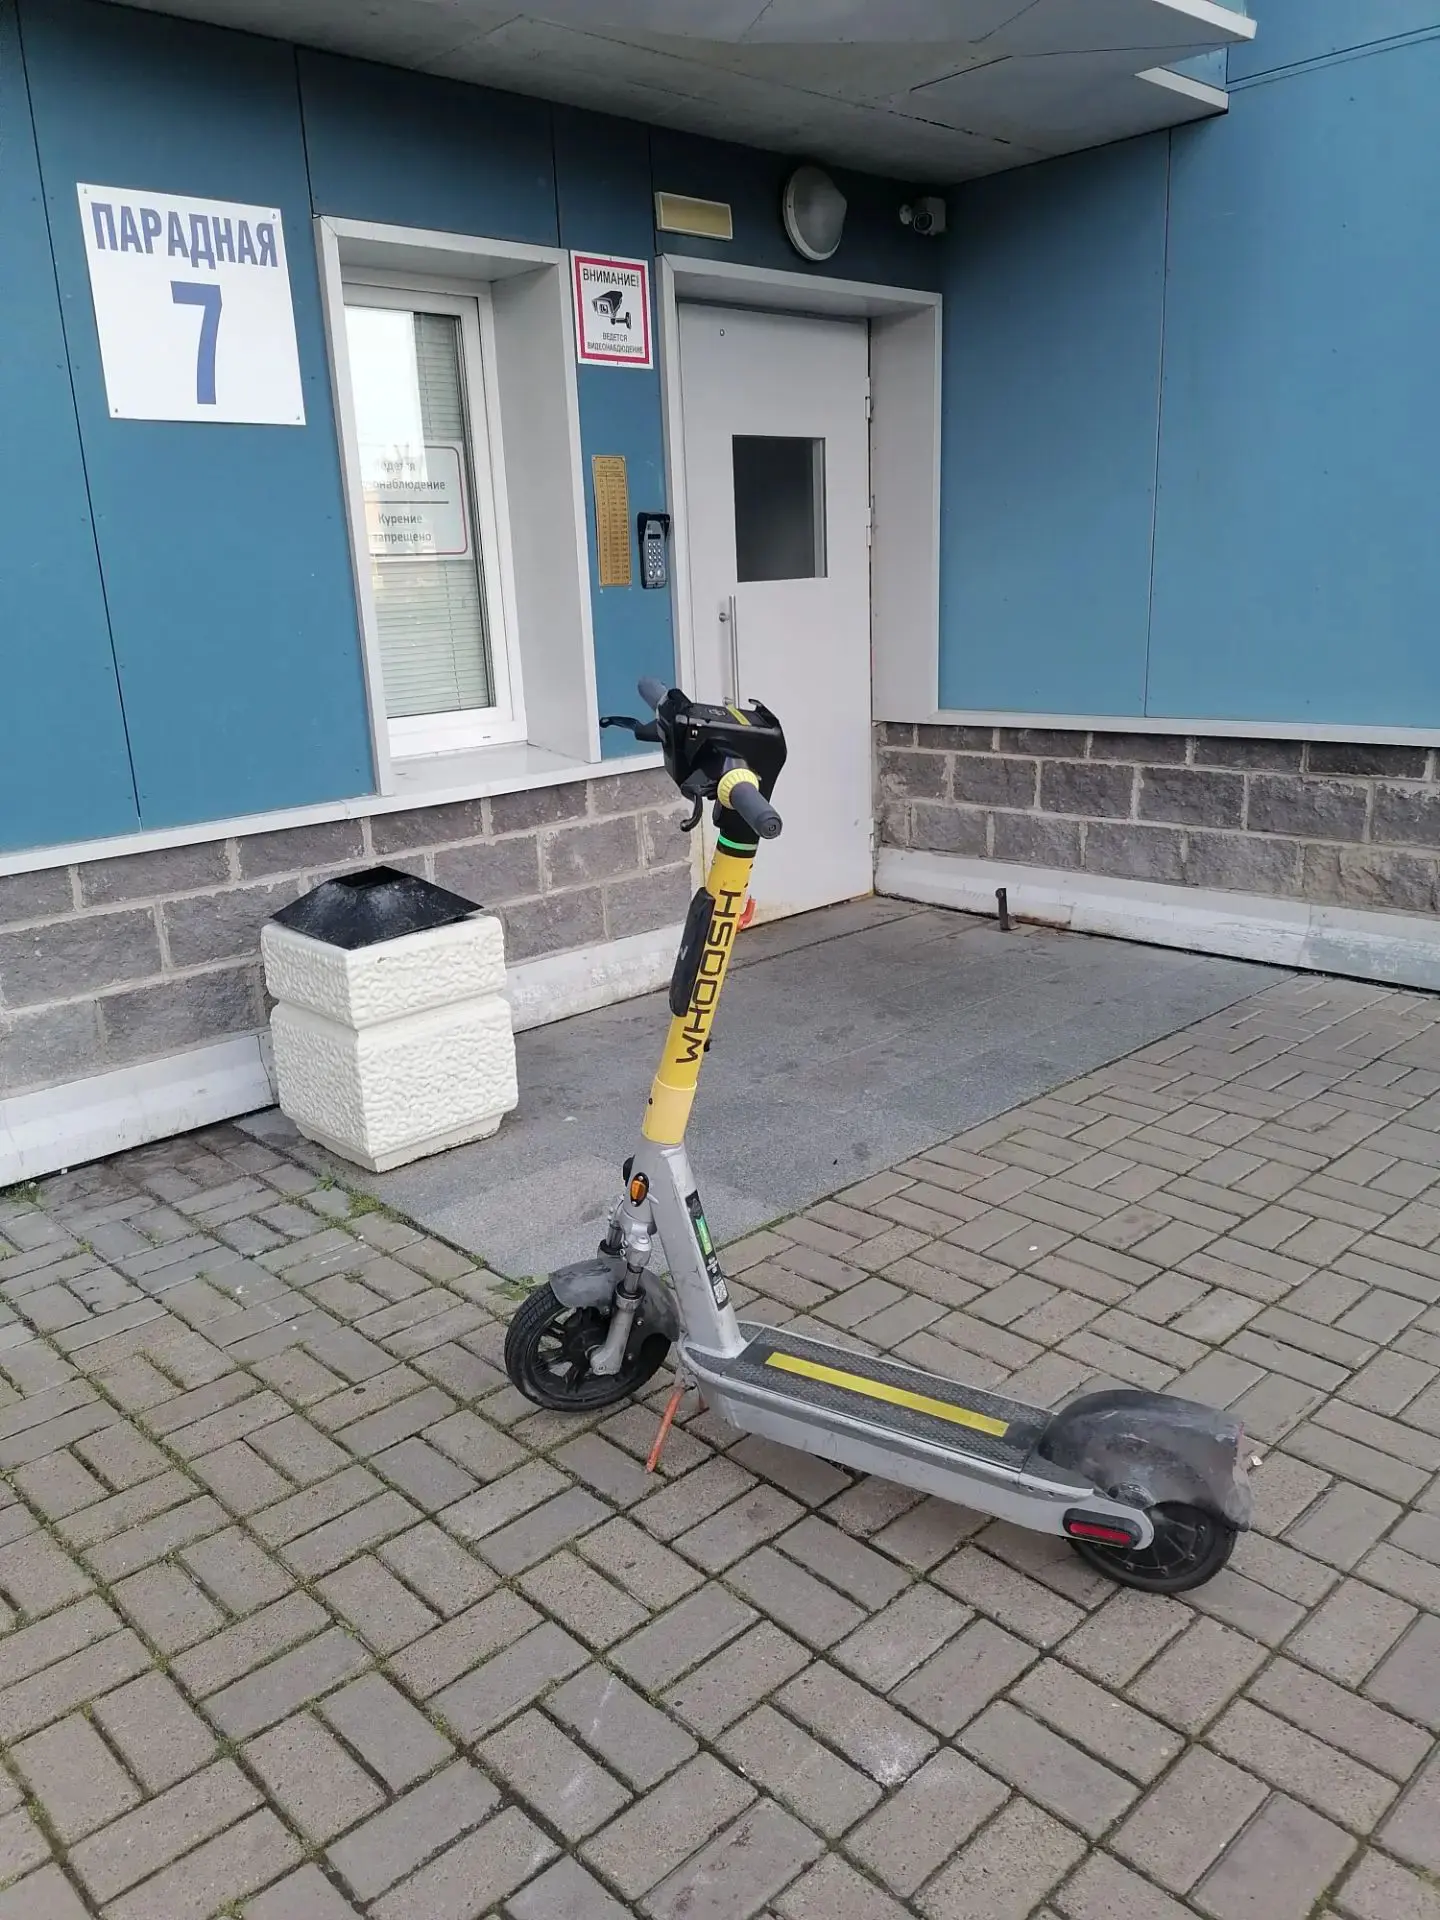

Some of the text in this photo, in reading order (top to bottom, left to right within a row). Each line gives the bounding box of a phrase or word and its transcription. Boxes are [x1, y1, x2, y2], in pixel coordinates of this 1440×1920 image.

[91, 202, 278, 270] ПАРАДНАЯ
[583, 267, 640, 288] ВНИМАНИЕ!
[170, 280, 223, 405] 7
[602, 332, 628, 342] ВЕДЕТСЯ
[587, 341, 643, 354] ВИДЕОНАБЛЮДЕНИЕ
[364, 478, 446, 492] онаблюдение
[378, 513, 423, 526] Курение
[372, 533, 432, 545] апрещено
[676, 889, 742, 1064] WHOOSH
